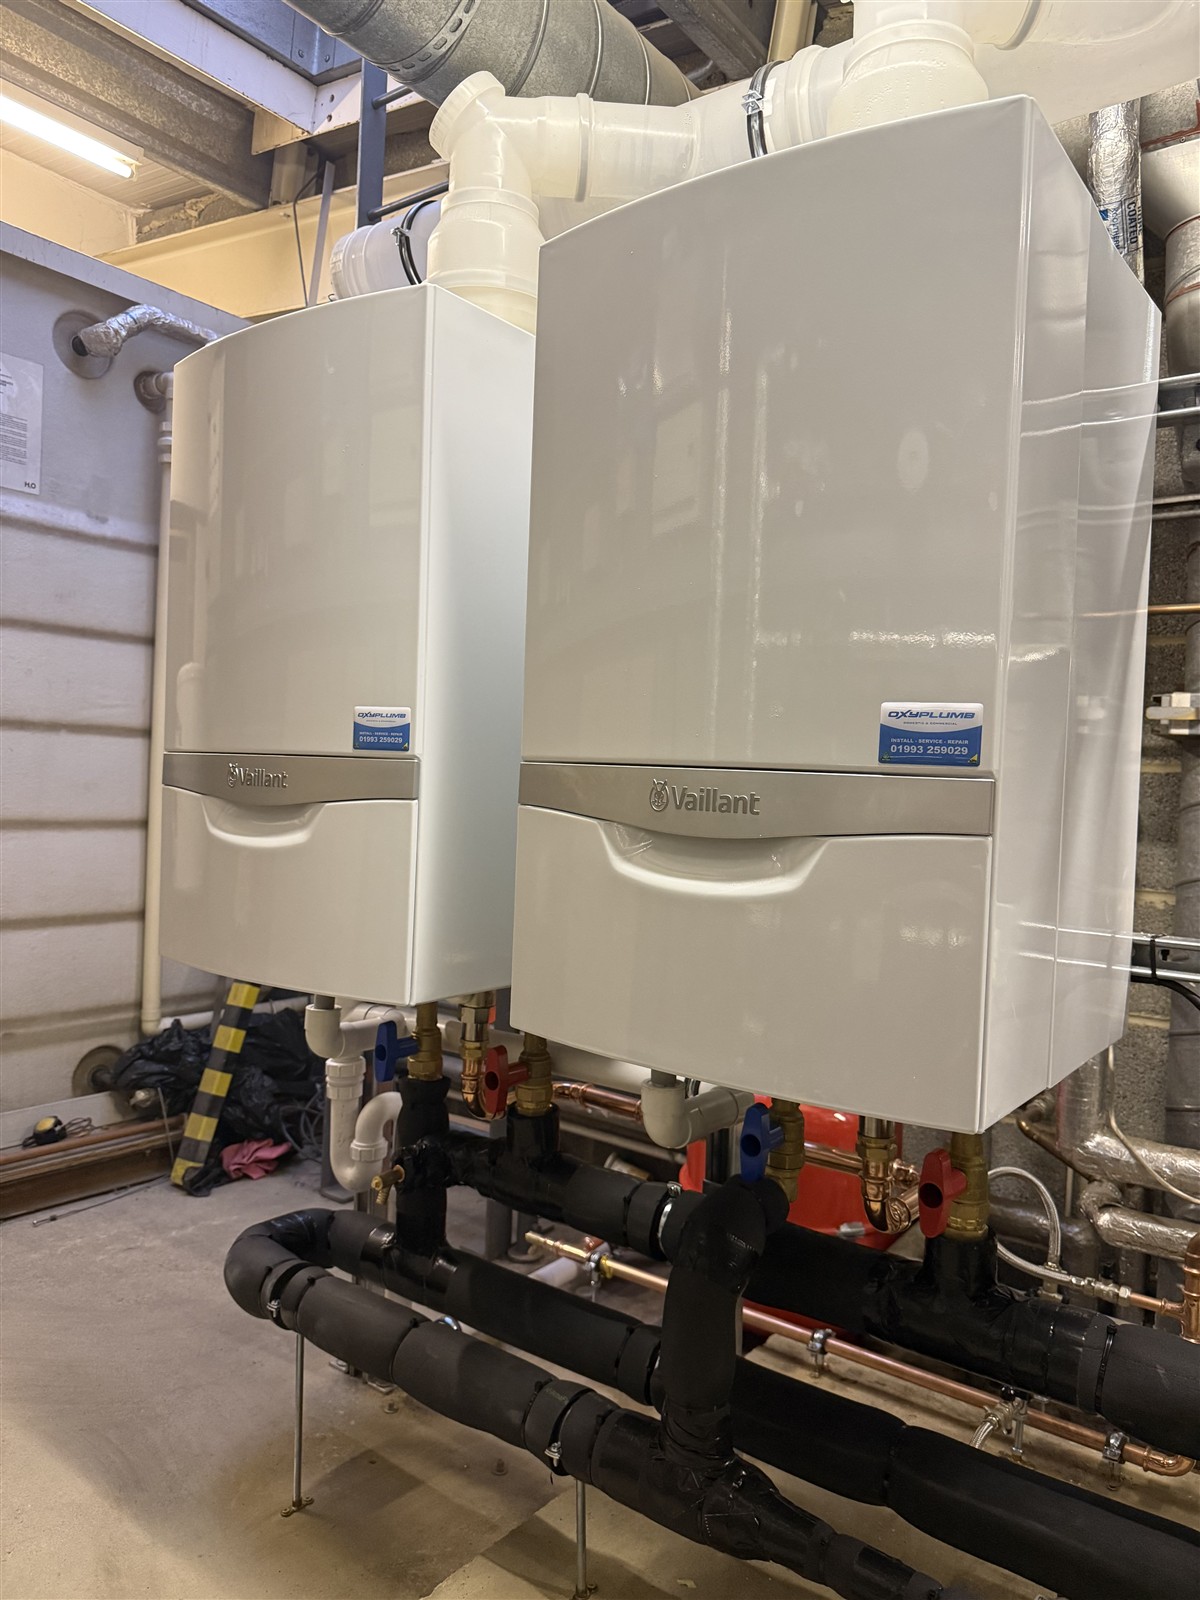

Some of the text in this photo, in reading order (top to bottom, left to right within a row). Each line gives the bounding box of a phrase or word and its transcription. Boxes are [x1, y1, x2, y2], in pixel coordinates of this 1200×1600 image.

[1127, 201, 1138, 244] COATED
[357, 711, 407, 719] OXYPLUMB
[888, 709, 976, 720] OXYPLUMB
[890, 744, 968, 755] 01993 259029
[239, 767, 289, 788] Vaillant
[671, 785, 761, 816] Vaillant
